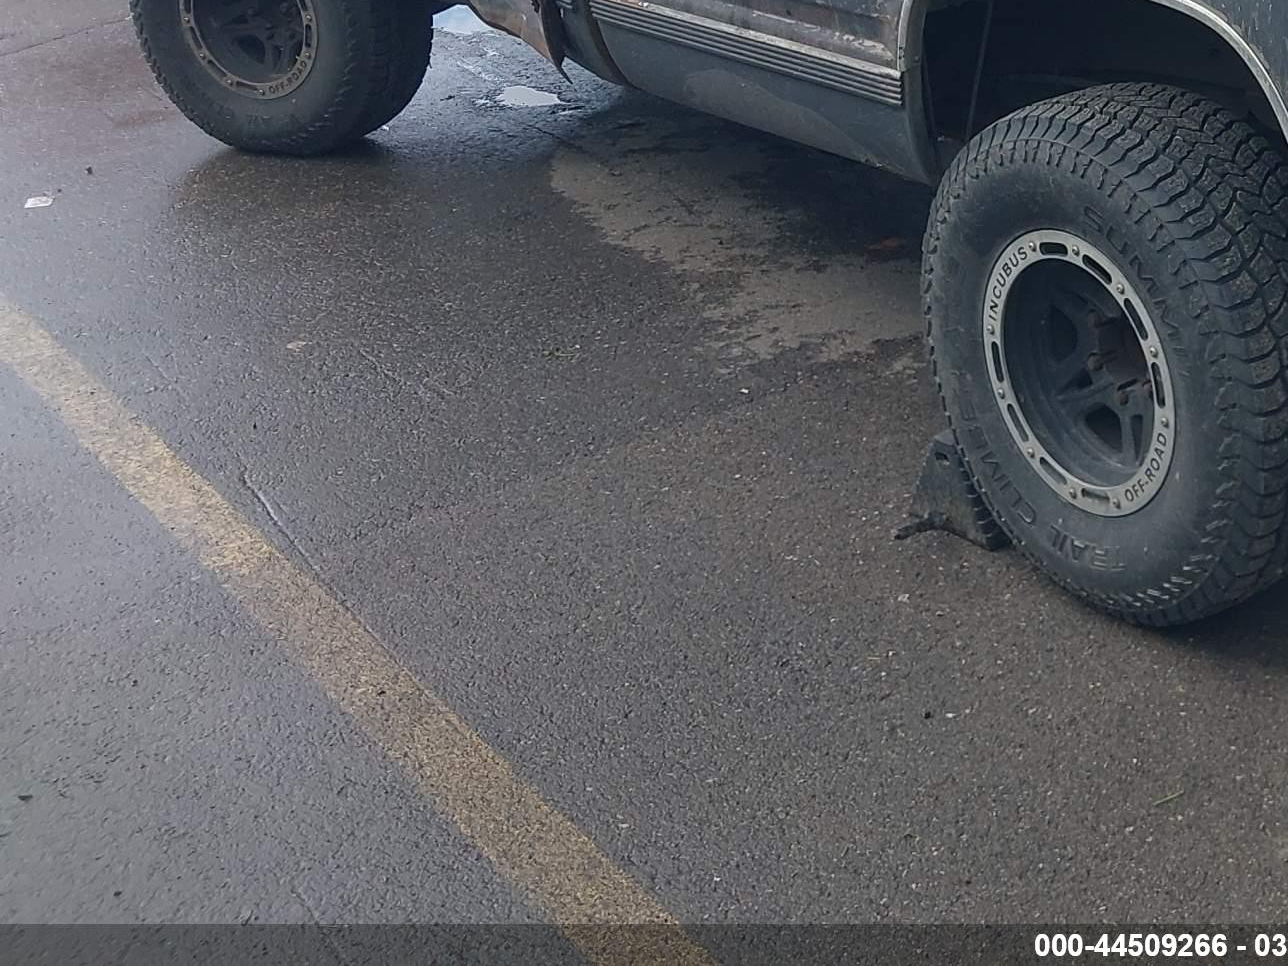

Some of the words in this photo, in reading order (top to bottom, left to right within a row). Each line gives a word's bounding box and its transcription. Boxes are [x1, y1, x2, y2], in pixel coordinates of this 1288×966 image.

[269, 60, 307, 94] OFF-ROAD
[988, 246, 1028, 321] INCUBUS
[960, 380, 1037, 525] CLIMBE
[1124, 432, 1167, 502] OFF-ROAD
